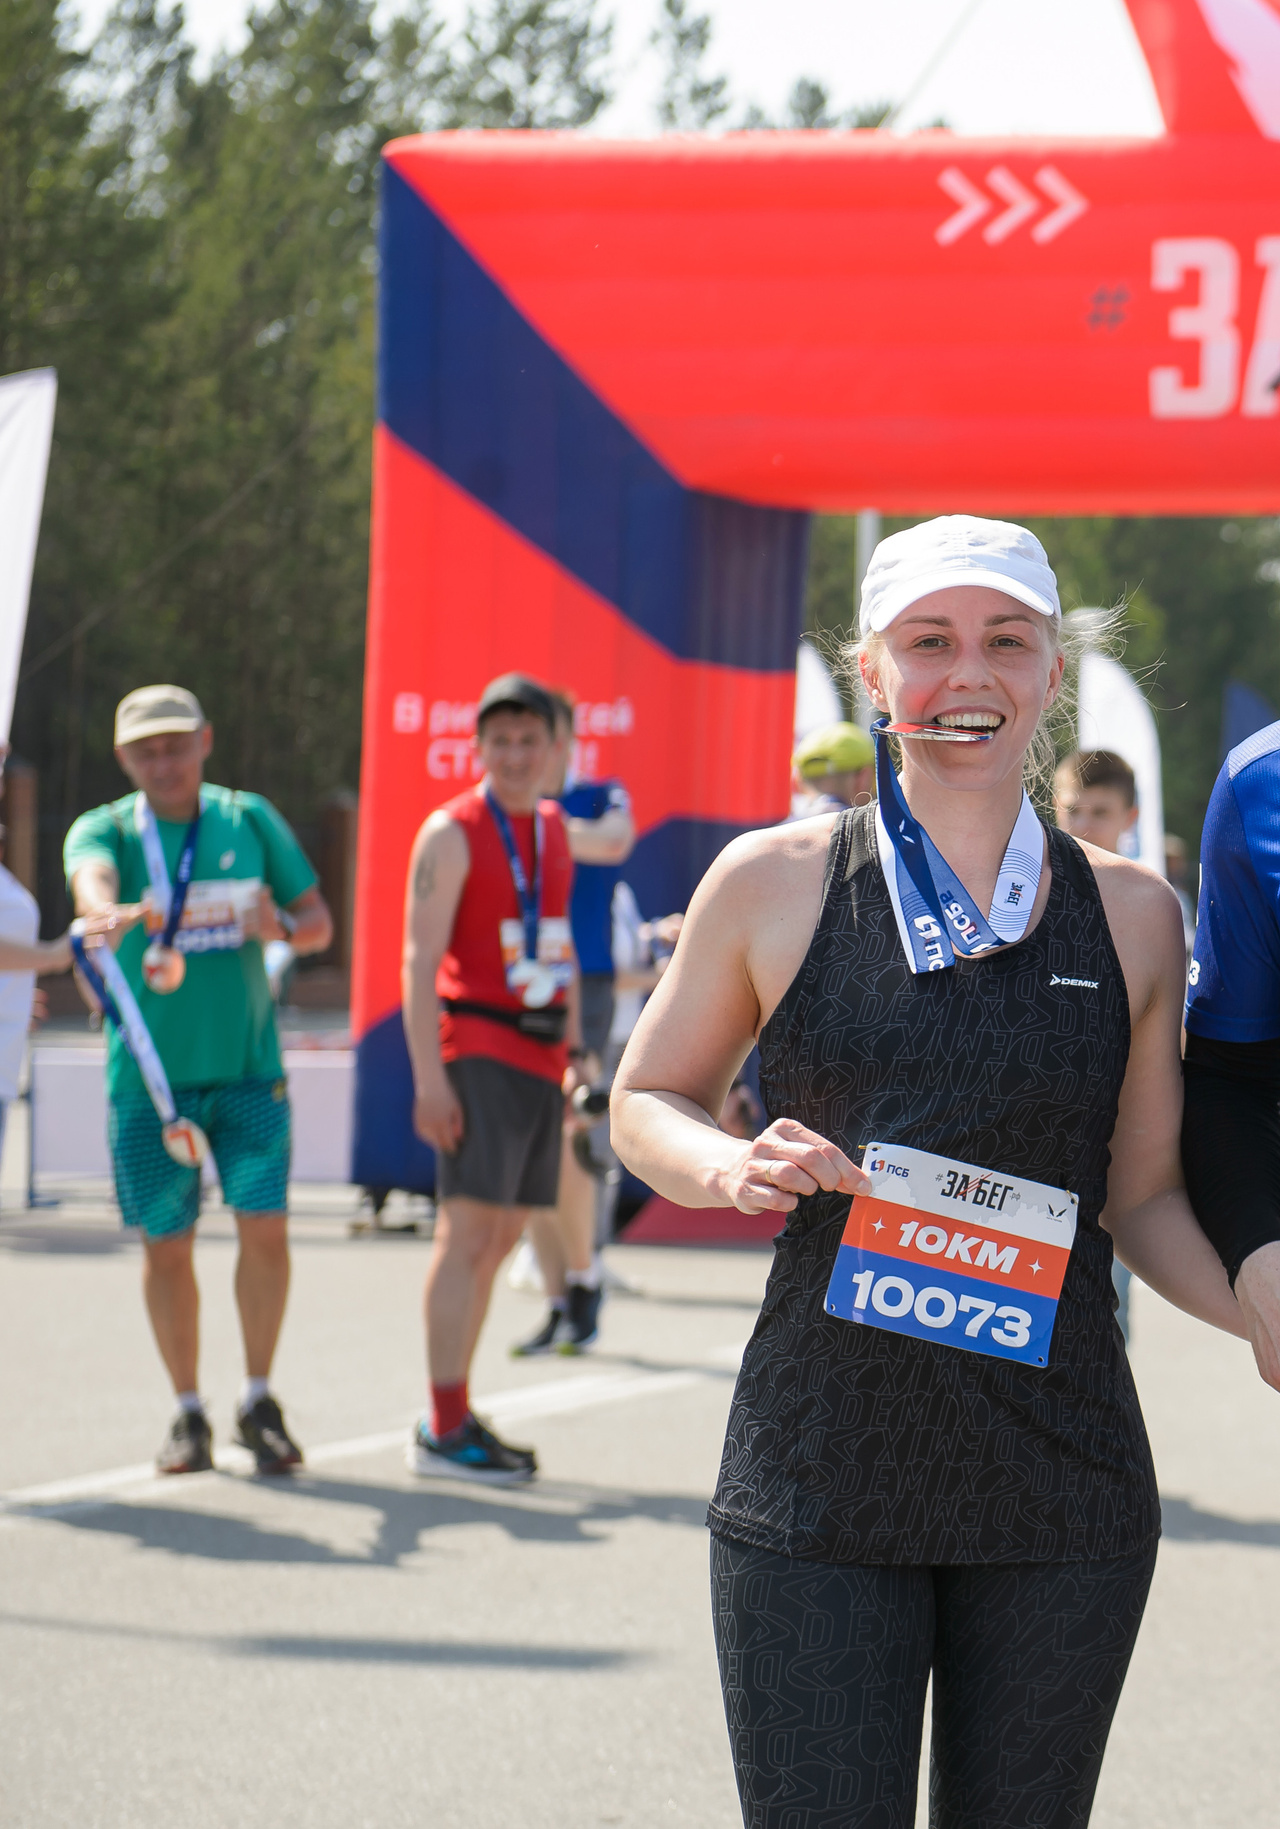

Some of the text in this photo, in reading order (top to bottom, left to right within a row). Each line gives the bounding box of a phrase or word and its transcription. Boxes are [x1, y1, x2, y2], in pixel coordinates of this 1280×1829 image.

[1060, 977, 1099, 989] DEMIX
[886, 1163, 910, 1178] ПСБ
[852, 1269, 1033, 1348] 10073
